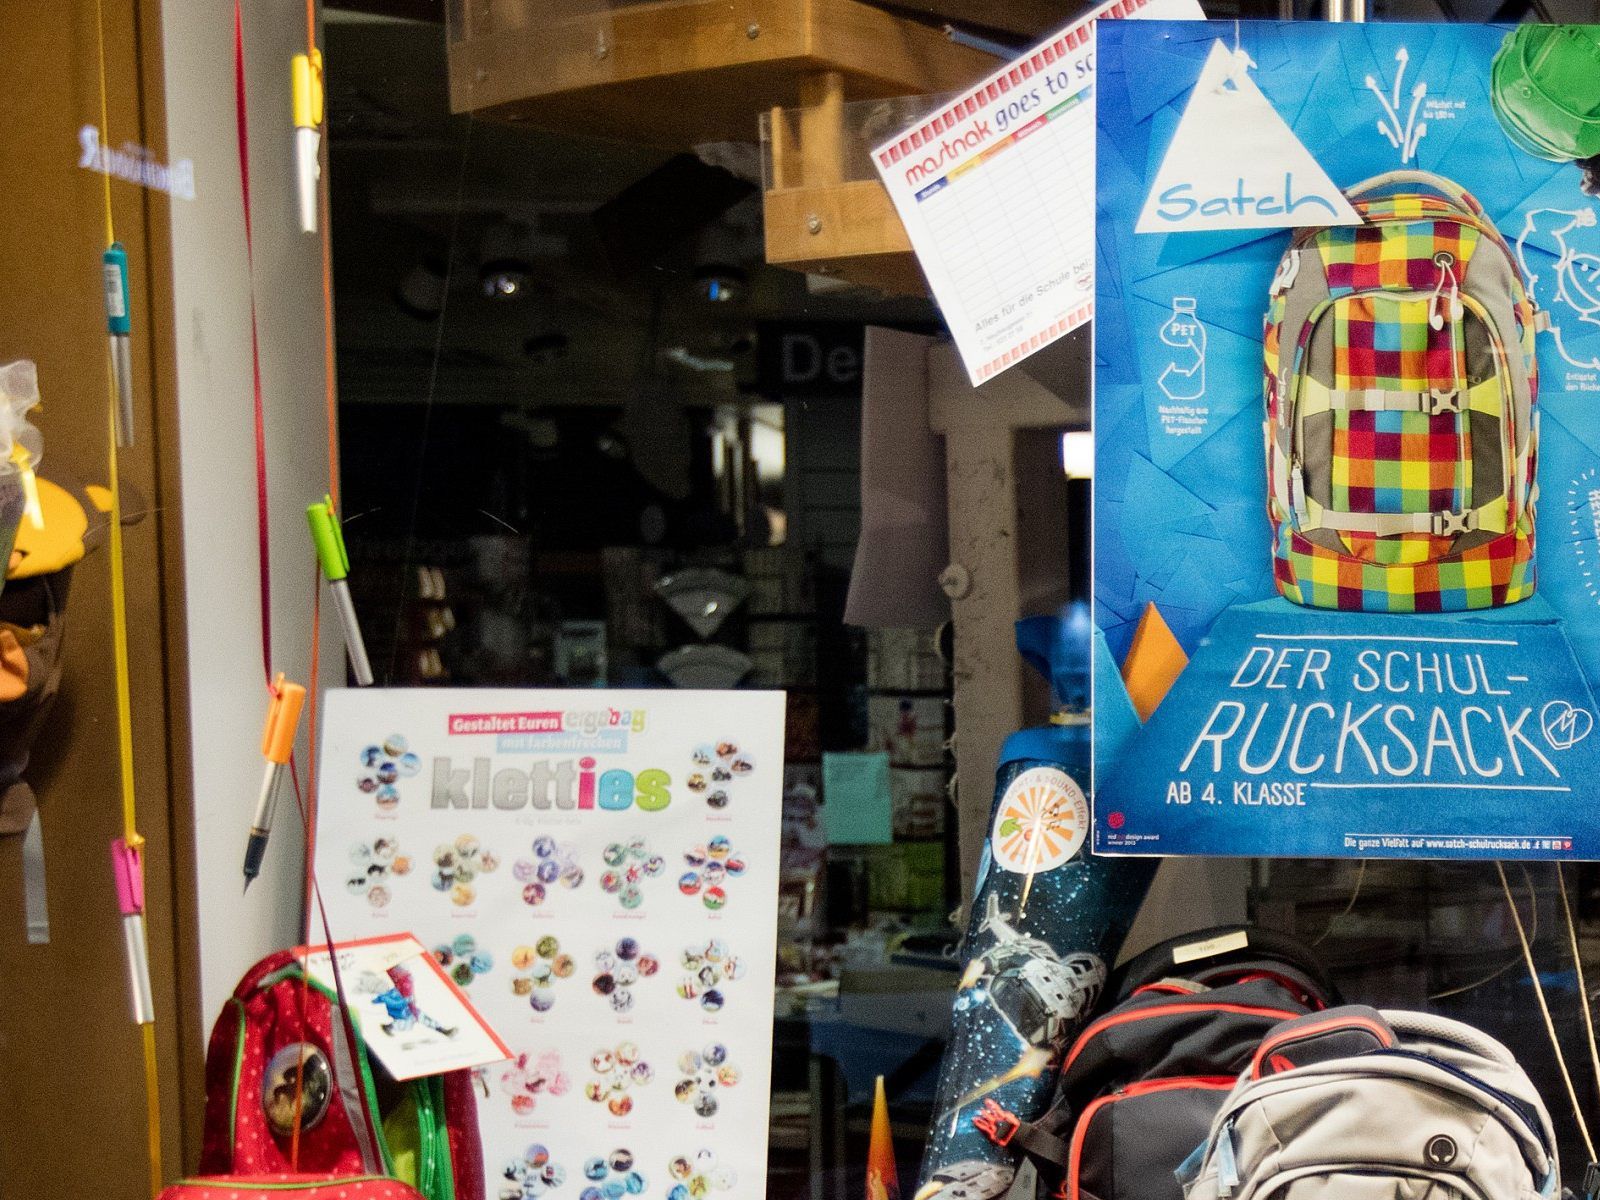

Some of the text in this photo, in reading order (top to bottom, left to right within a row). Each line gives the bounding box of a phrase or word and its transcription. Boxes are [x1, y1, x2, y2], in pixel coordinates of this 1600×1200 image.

[904, 71, 1069, 186] mastnak goes to
[1156, 172, 1339, 222] Satch
[1037, 271, 1071, 296] Schule
[1170, 321, 1197, 337] PET
[1230, 647, 1529, 696] DER SCHUL-
[453, 707, 647, 735] Gestaltet Euren ergobag
[1179, 701, 1561, 778] RUCKSACK
[430, 756, 673, 812] kletties
[1166, 782, 1307, 807] AB 4. KLASSE
[1344, 837, 1357, 848] Die
[1358, 839, 1380, 850] ganze
[1382, 838, 1410, 849] Vielfalt
[1411, 838, 1425, 849] auf
